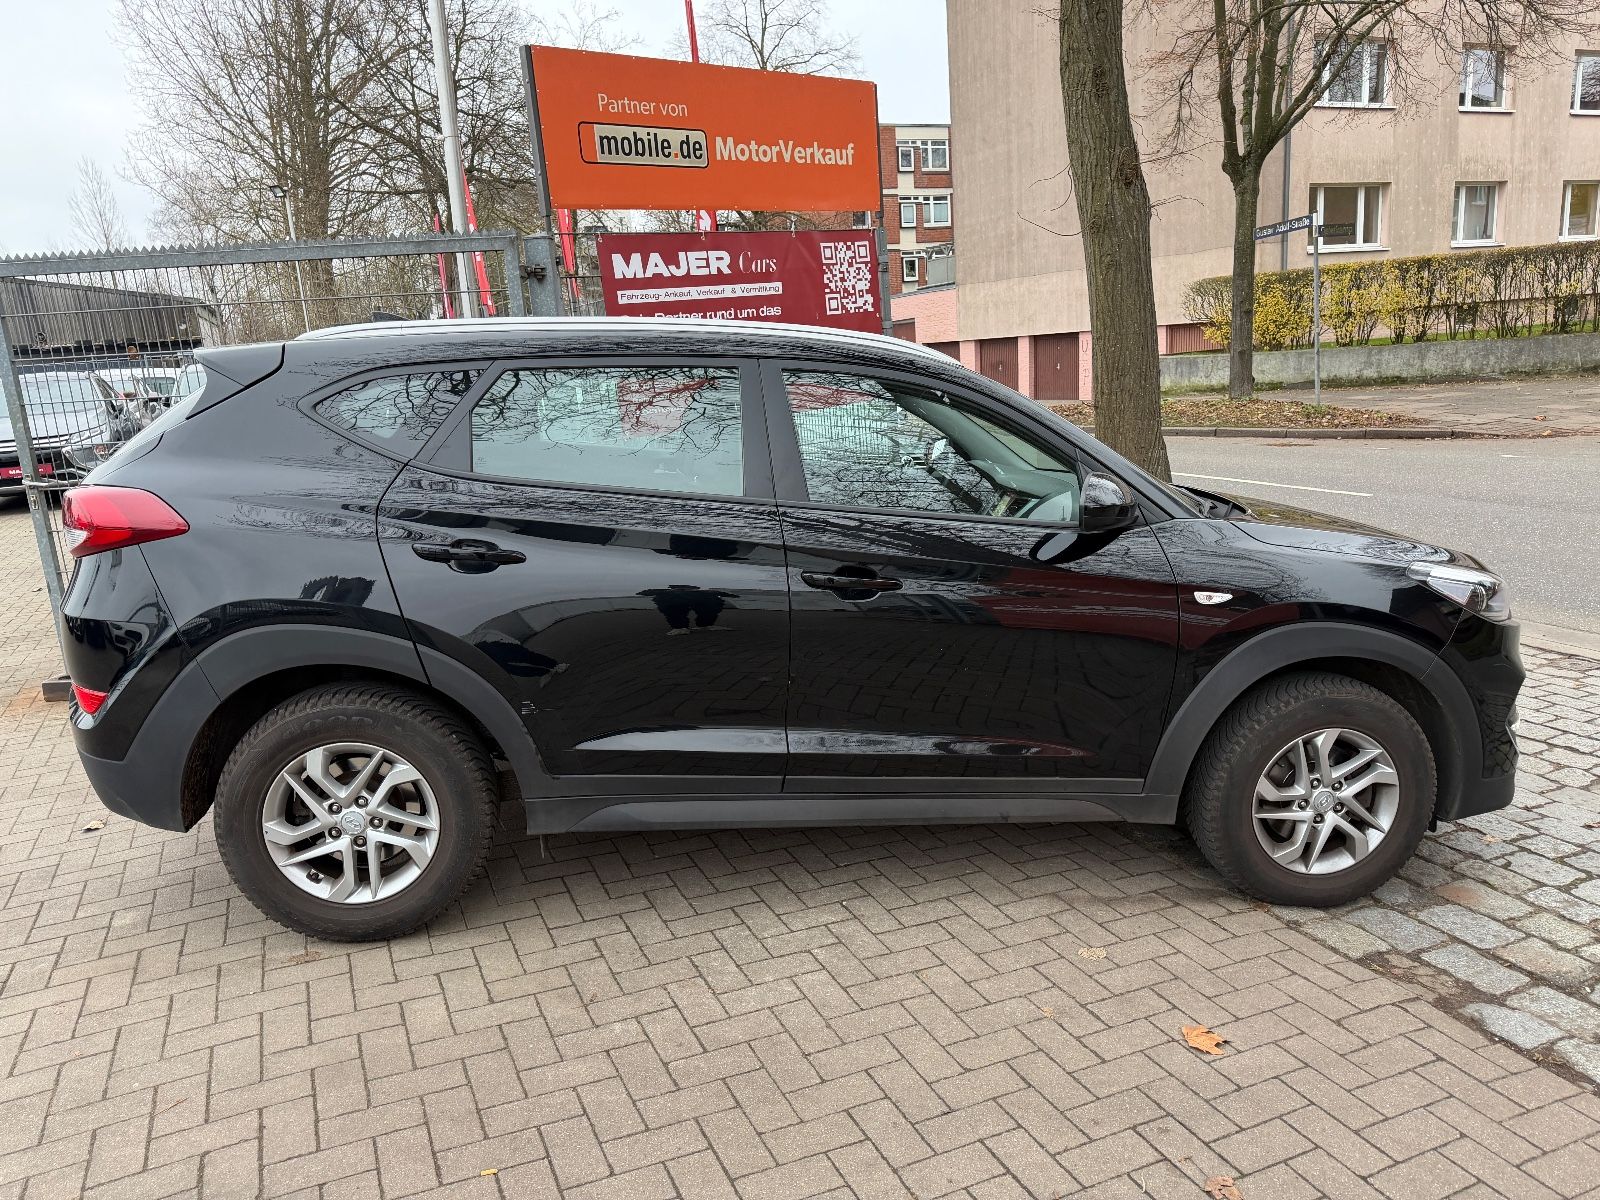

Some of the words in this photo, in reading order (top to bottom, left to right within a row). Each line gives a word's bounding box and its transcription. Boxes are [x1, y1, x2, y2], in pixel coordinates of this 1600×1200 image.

[597, 93, 655, 115] Partner
[660, 102, 688, 117] von
[598, 131, 703, 160] mobile.de
[715, 136, 854, 166] MotorVerkauf
[611, 250, 732, 279] MAJER
[739, 251, 777, 274] Cars
[695, 288, 725, 297] Verkauf
[731, 287, 737, 295] &
[706, 308, 735, 320] rund
[737, 308, 757, 319] um
[759, 305, 782, 316] das
